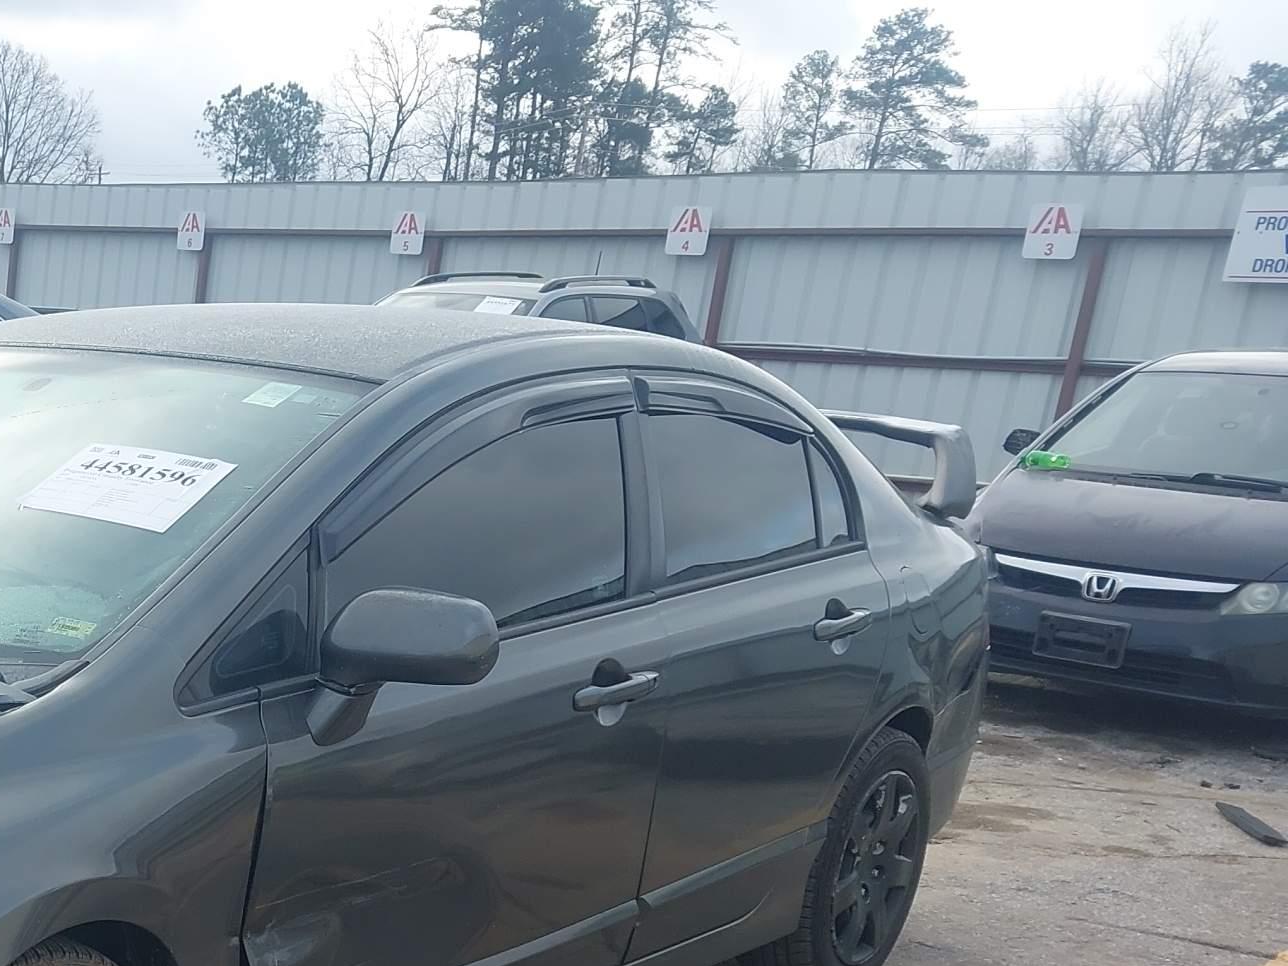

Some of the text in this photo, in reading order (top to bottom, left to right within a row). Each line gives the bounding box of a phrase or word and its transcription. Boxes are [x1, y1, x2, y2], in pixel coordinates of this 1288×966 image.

[186, 238, 193, 248] 6
[402, 240, 410, 252] 5
[681, 239, 690, 253] 4
[1043, 242, 1055, 256] 3
[1251, 258, 1288, 273] DRO
[79, 457, 201, 488] 44581596
